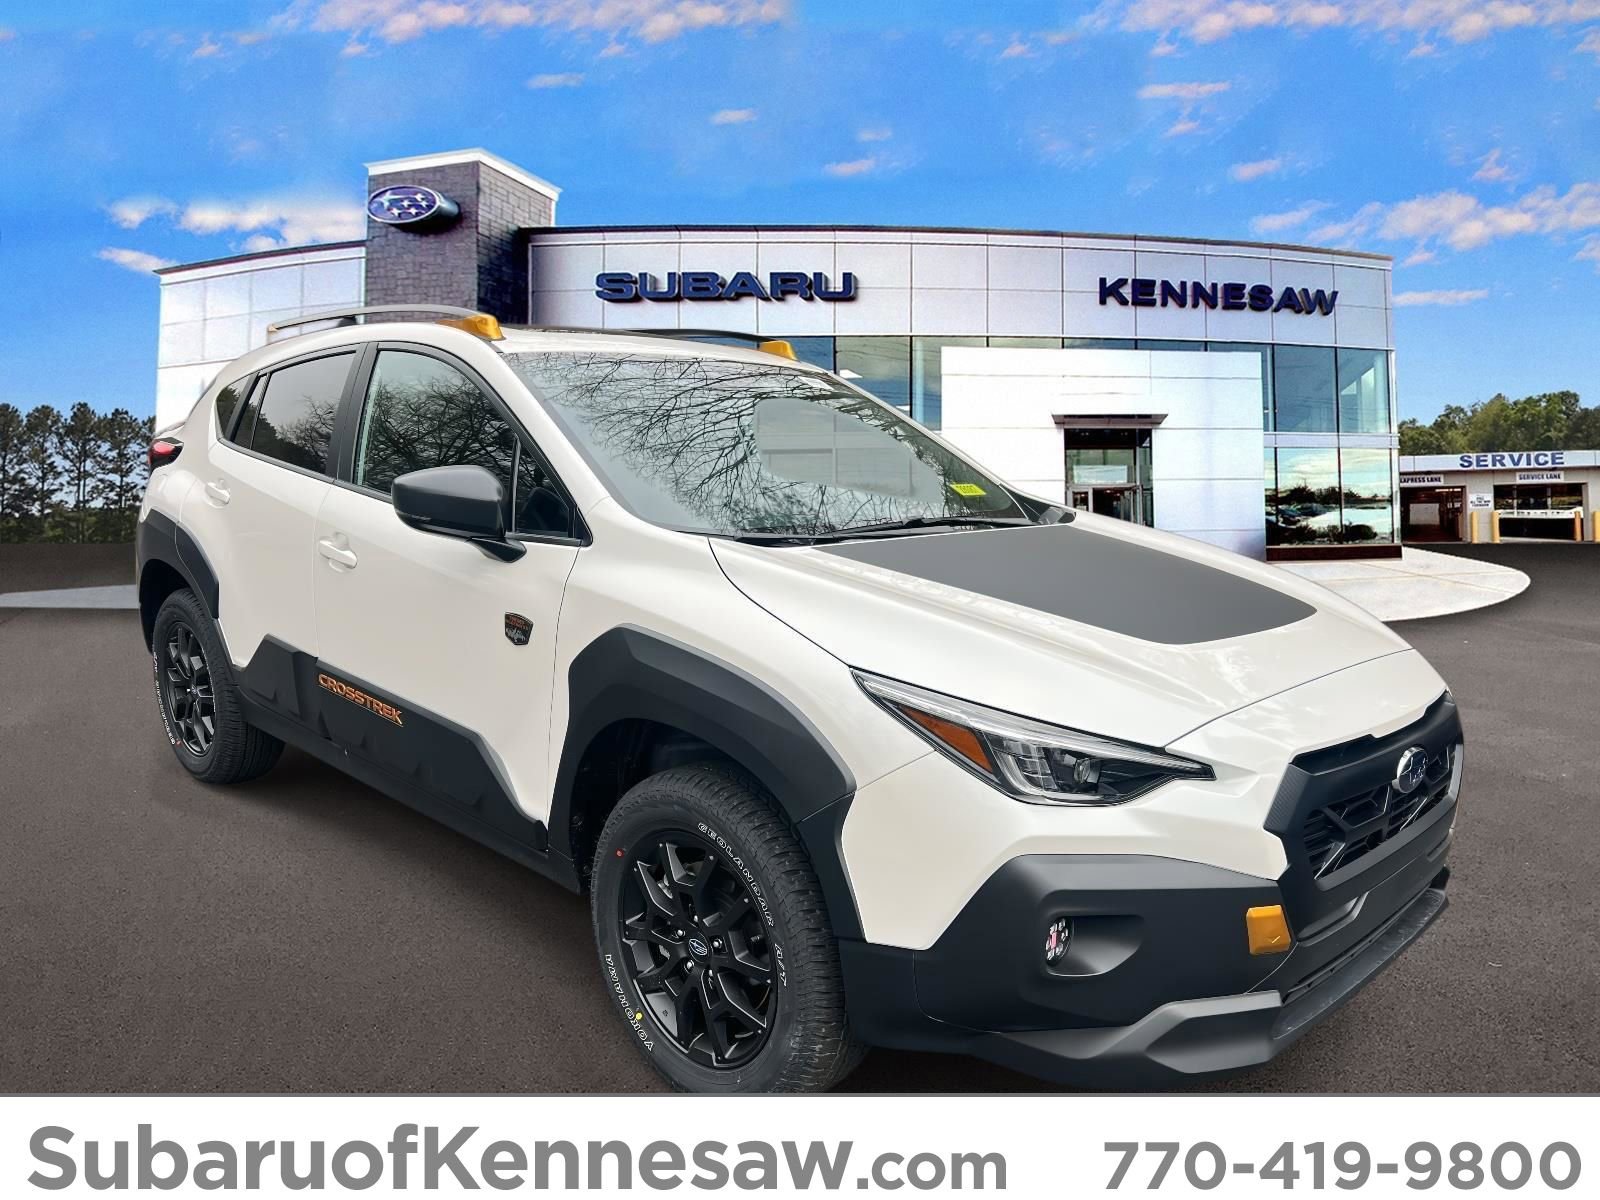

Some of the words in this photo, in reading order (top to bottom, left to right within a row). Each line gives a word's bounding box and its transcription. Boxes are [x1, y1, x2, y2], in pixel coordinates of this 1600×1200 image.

[595, 271, 857, 303] SUBARU
[1099, 277, 1339, 316] KENNESAW
[1459, 452, 1565, 469] SERVICE
[318, 673, 404, 725] CROSSTREK
[698, 822, 775, 928] GEOLANDAR
[604, 954, 656, 1052] YOKOHAMA
